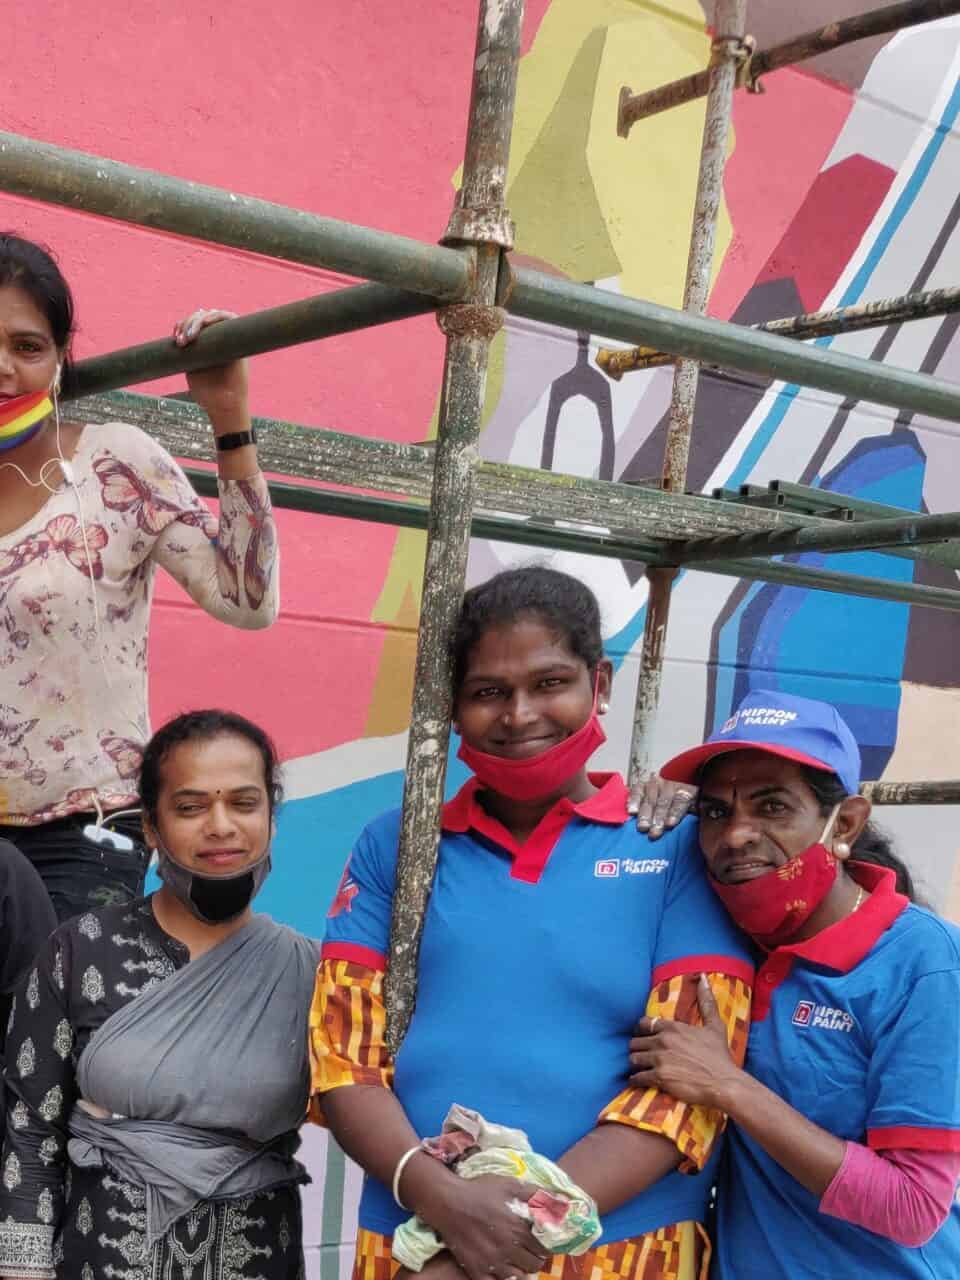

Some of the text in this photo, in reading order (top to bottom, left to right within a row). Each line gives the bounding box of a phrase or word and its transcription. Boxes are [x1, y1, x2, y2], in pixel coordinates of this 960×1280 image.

[741, 707, 798, 721] NIPPON
[743, 717, 789, 727] PAINT
[623, 861, 666, 874] PAINT
[811, 1016, 853, 1033] PAINT
